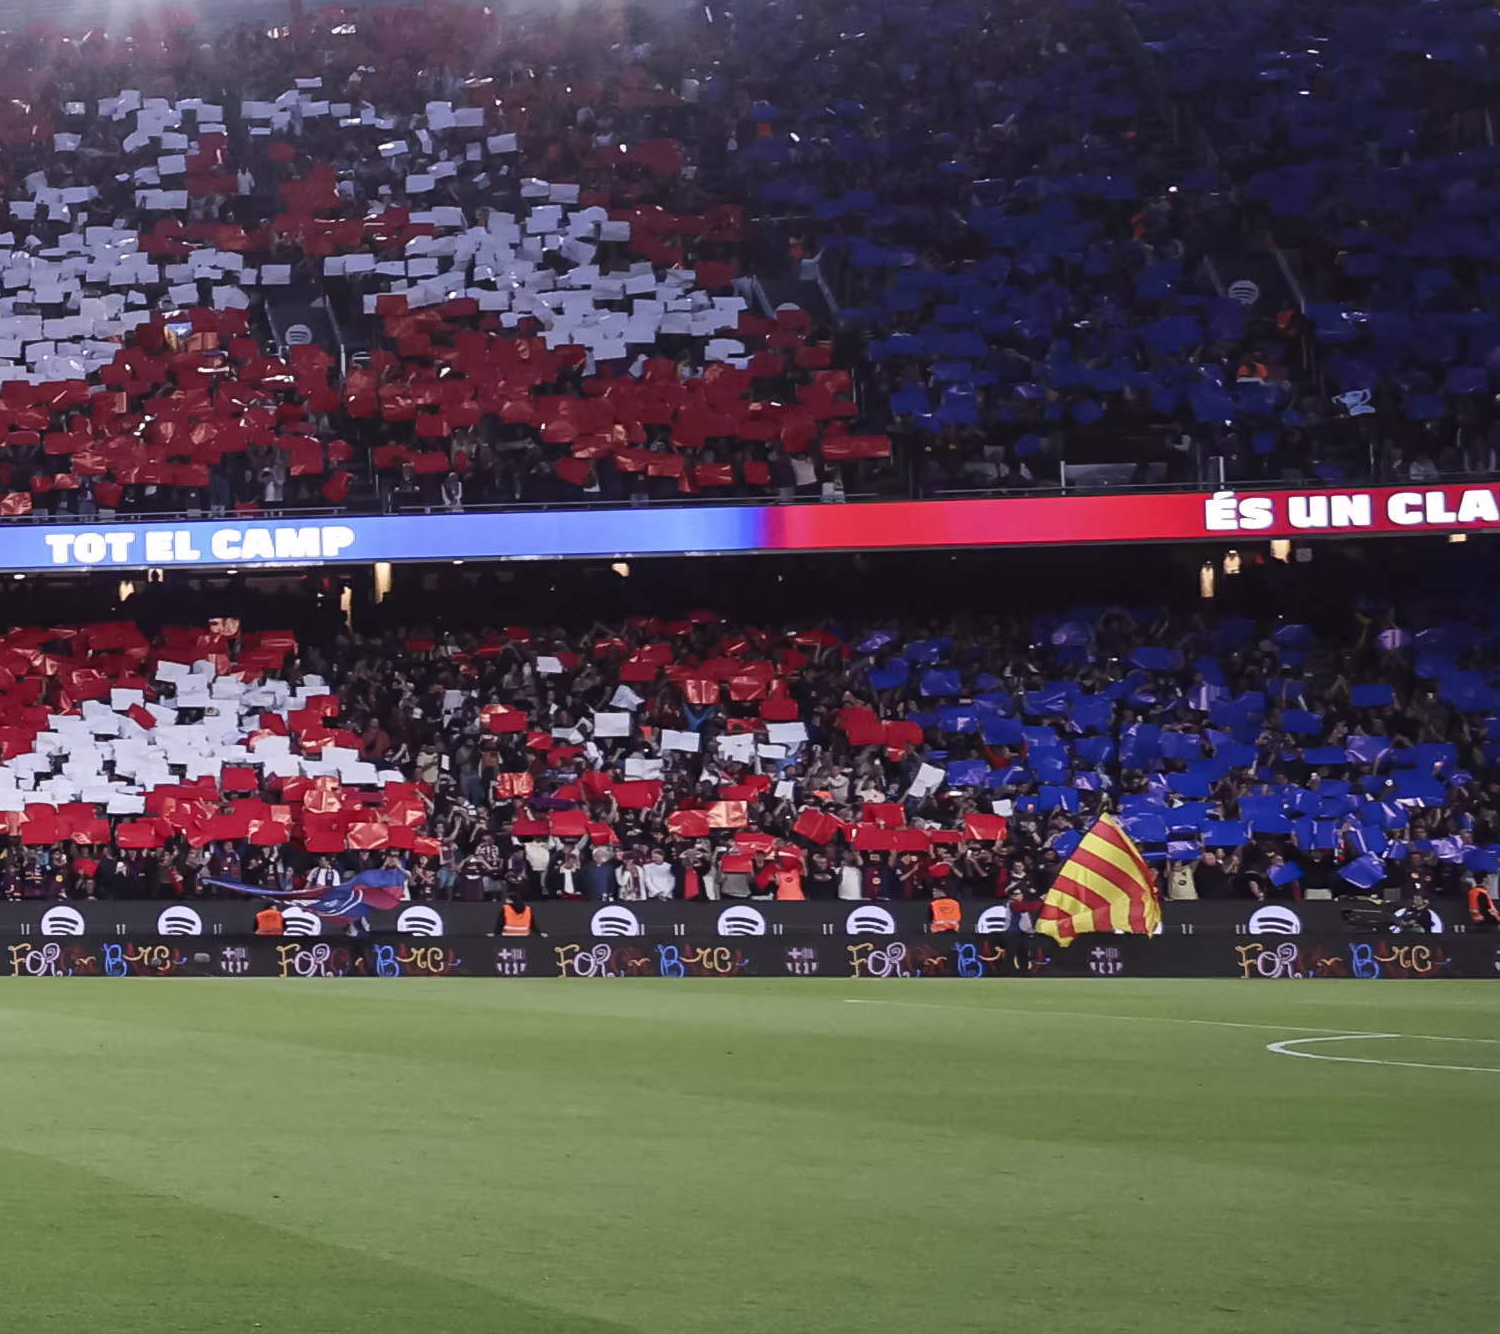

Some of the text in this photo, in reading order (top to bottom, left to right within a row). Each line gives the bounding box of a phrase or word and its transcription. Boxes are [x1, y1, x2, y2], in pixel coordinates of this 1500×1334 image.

[1204, 491, 1273, 530] ÉS
[1288, 494, 1372, 528] UN
[45, 526, 354, 564] TOT EL CAMP
